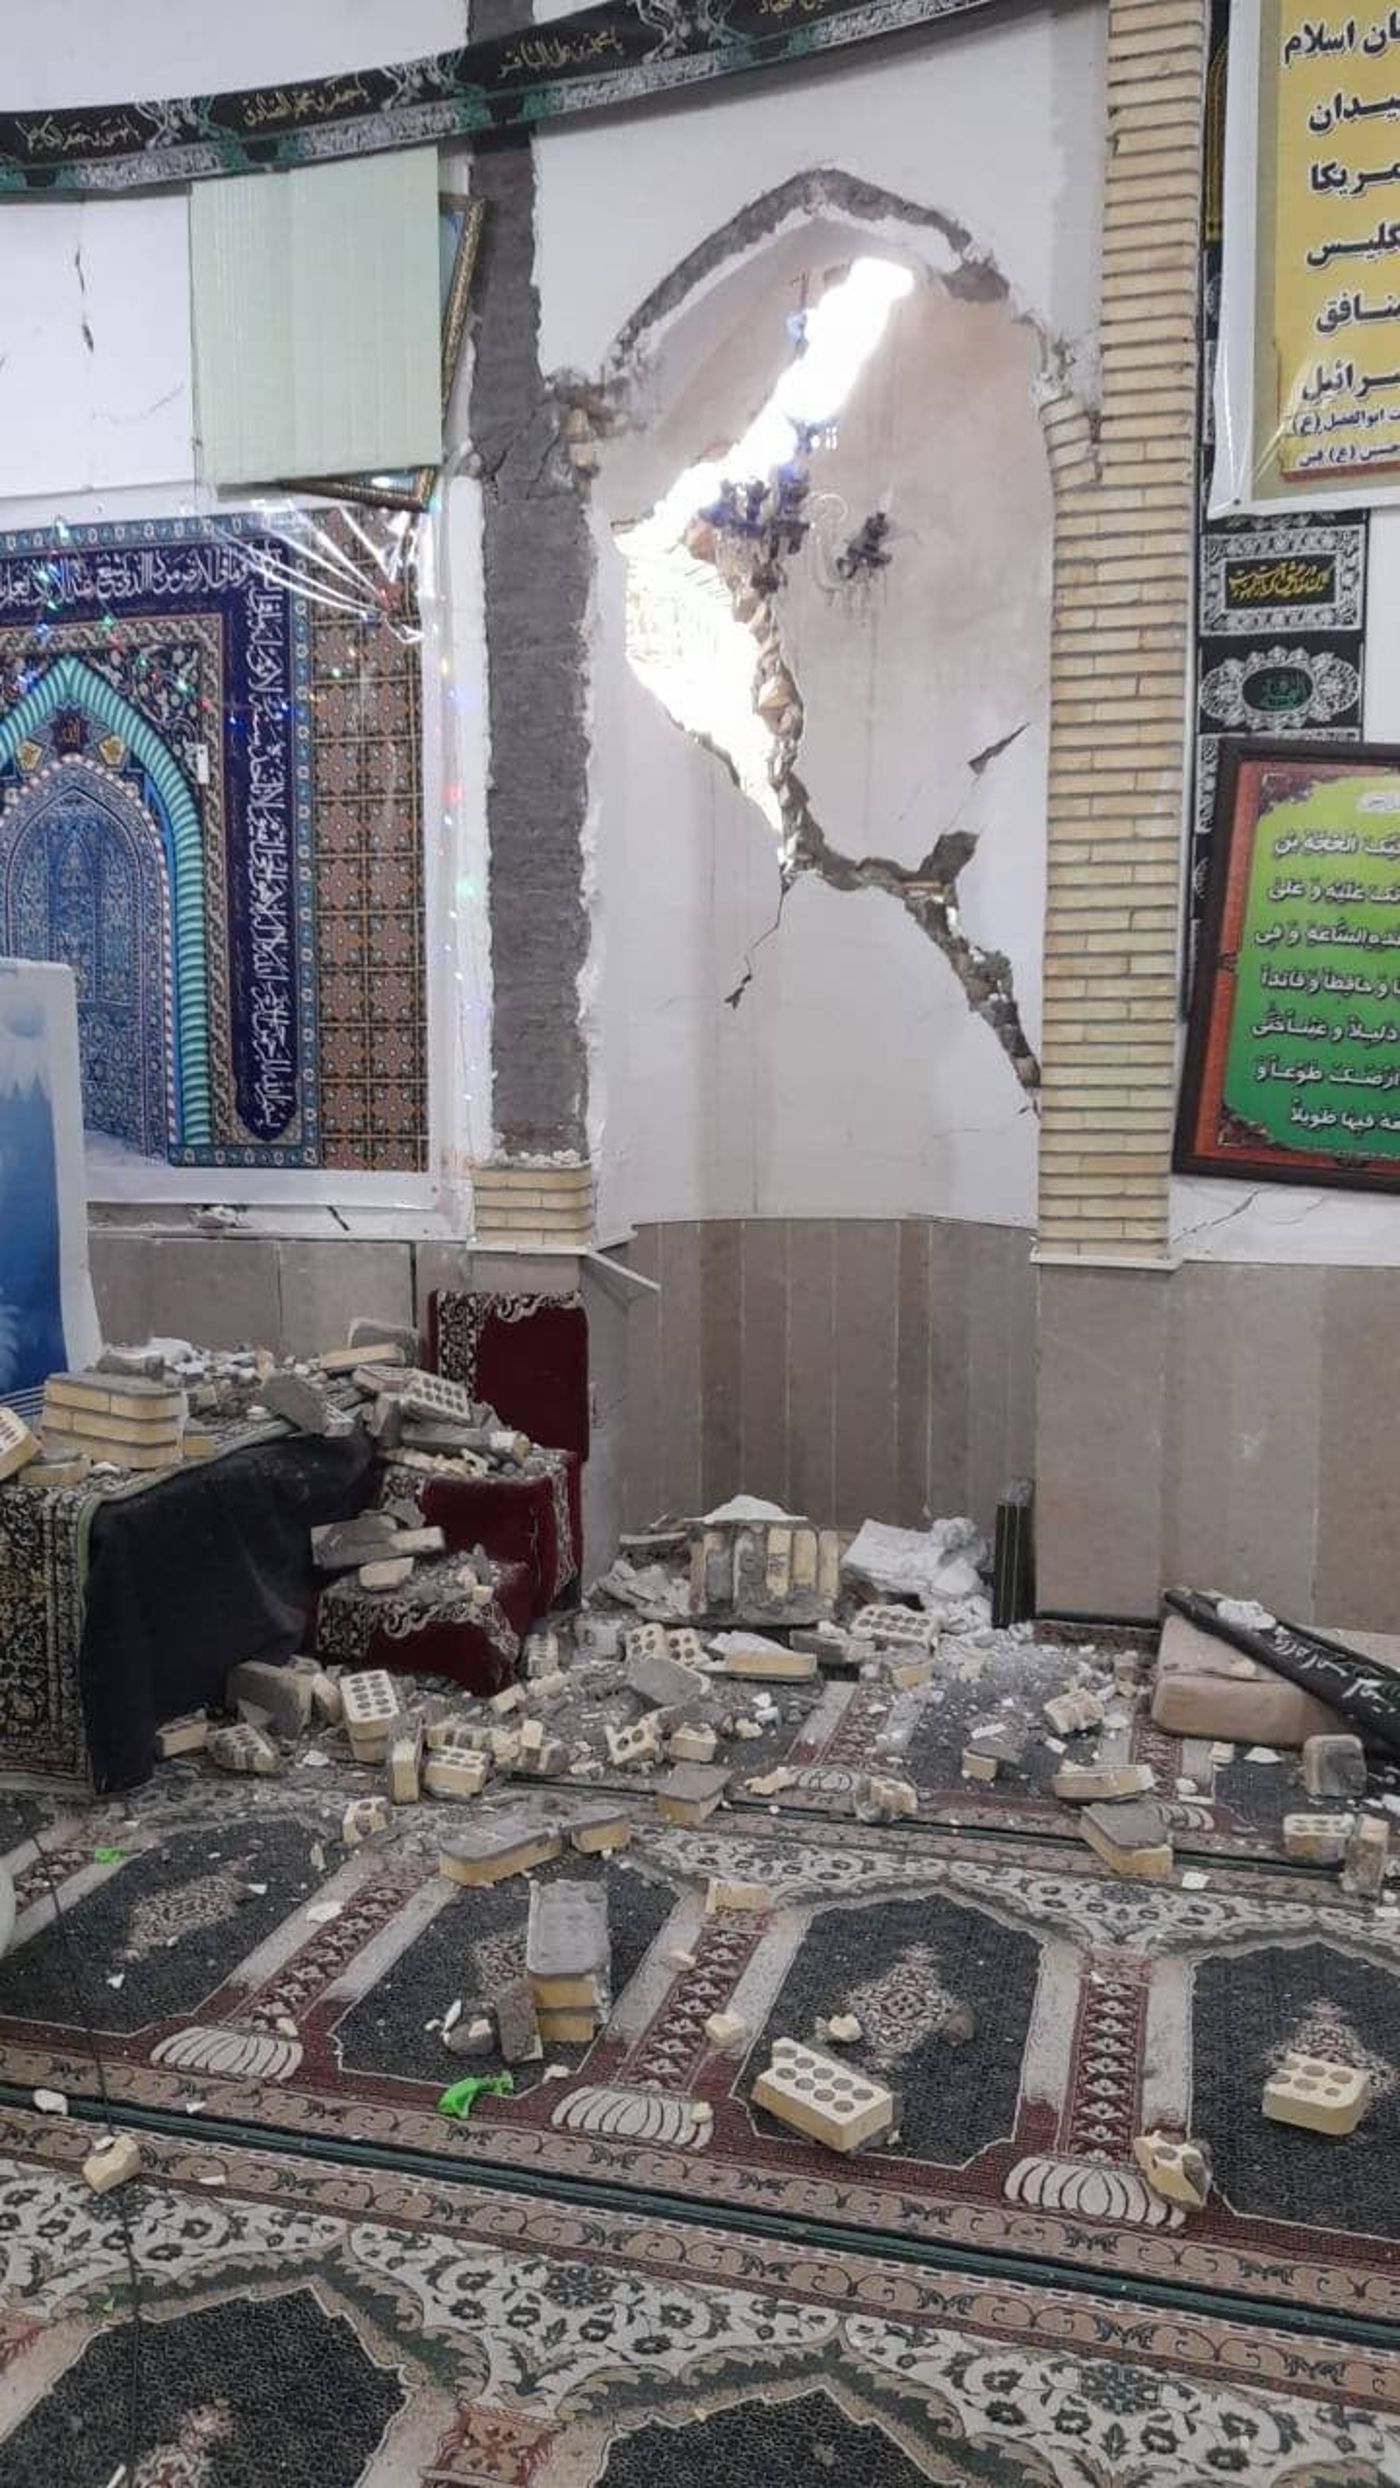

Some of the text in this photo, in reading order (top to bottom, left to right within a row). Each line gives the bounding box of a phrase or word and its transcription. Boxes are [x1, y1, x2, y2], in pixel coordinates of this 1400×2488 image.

[1284, 9, 1400, 66] ان اسلام
[1307, 92, 1400, 134] یدان
[1311, 161, 1400, 196] مریکا
